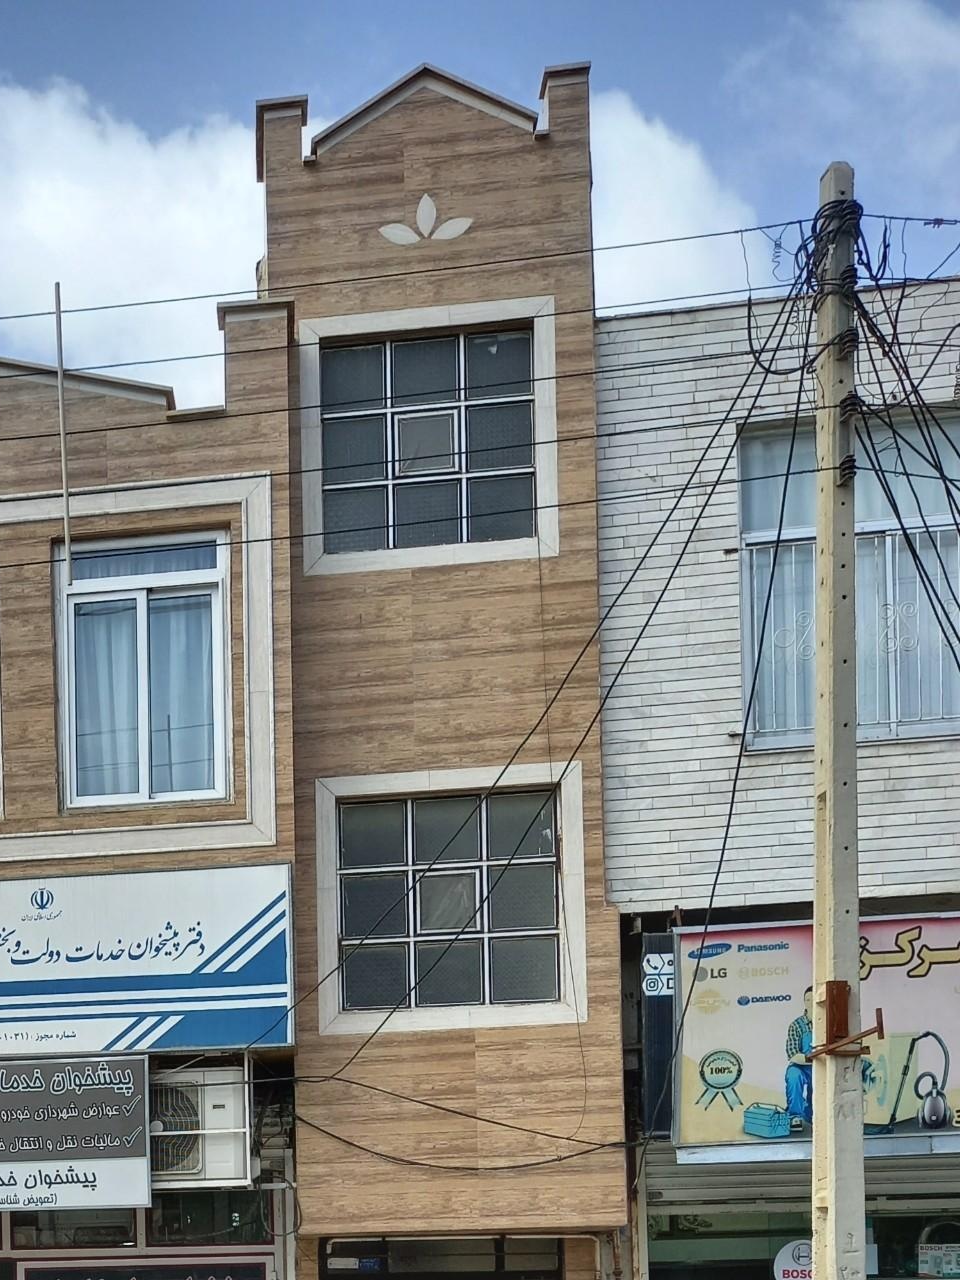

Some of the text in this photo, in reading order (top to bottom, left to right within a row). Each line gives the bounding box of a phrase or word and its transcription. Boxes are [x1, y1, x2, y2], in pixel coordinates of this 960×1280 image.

[128, 921, 180, 961] پیشخوان
[172, 921, 206, 961] دفتر
[737, 941, 789, 953] Panasonic
[10, 937, 61, 966] دولت
[65, 938, 125, 963] خدمات
[710, 967, 789, 979] LG BOSCH
[751, 994, 792, 1003] DAEWOO
[36, 1032, 53, 1042] مجوز
[55, 1030, 77, 1041] شماره
[710, 1066, 733, 1075] 100%
[50, 1062, 135, 1097] پیشخوان
[0, 1107, 31, 1123] خودرو
[34, 1102, 79, 1121] شهرداری
[82, 1104, 120, 1119] عوارض
[9, 1136, 43, 1153] انتقال
[46, 1140, 53, 1152] و
[56, 1135, 78, 1151] نقل
[81, 1134, 121, 1150] مالیات
[24, 1165, 97, 1191] پیشخوان
[782, 1269, 812, 1279] BOSC
